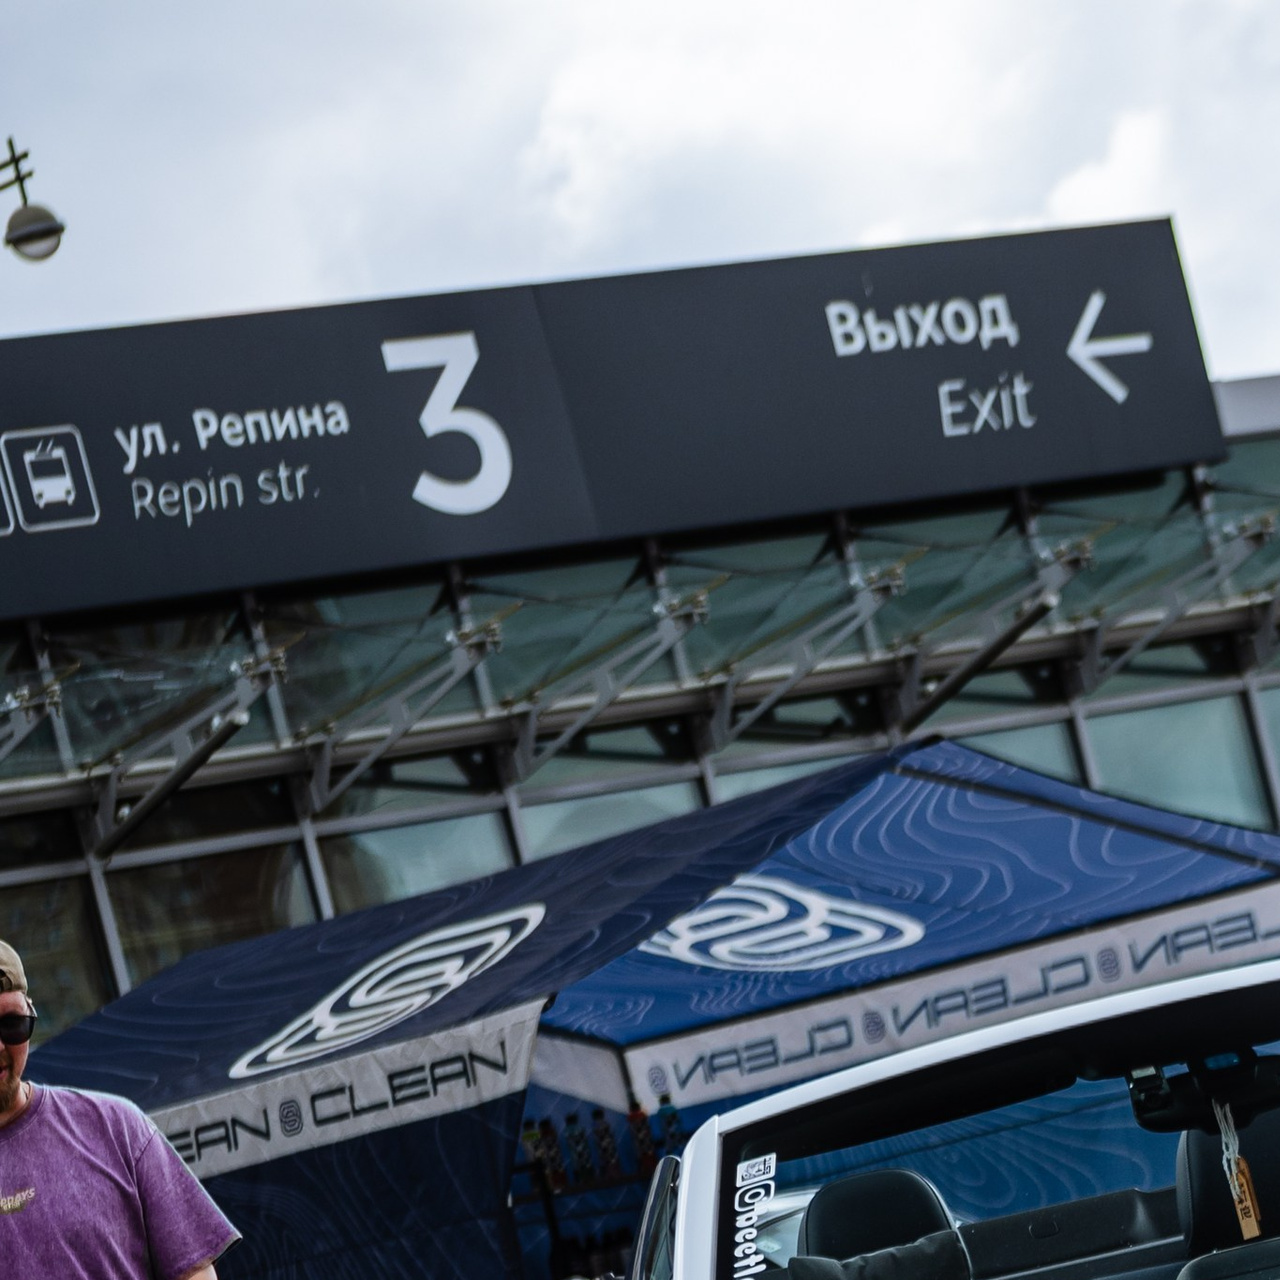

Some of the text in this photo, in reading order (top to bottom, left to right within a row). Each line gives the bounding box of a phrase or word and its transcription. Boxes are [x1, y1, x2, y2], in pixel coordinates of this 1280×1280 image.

[824, 293, 1020, 358] Выход
[113, 399, 350, 475] ул. Репина
[380, 331, 513, 516] 3
[937, 369, 1038, 438] Exit
[131, 458, 320, 528] Repin str.
[164, 1040, 508, 1164] EAN CLEAN
